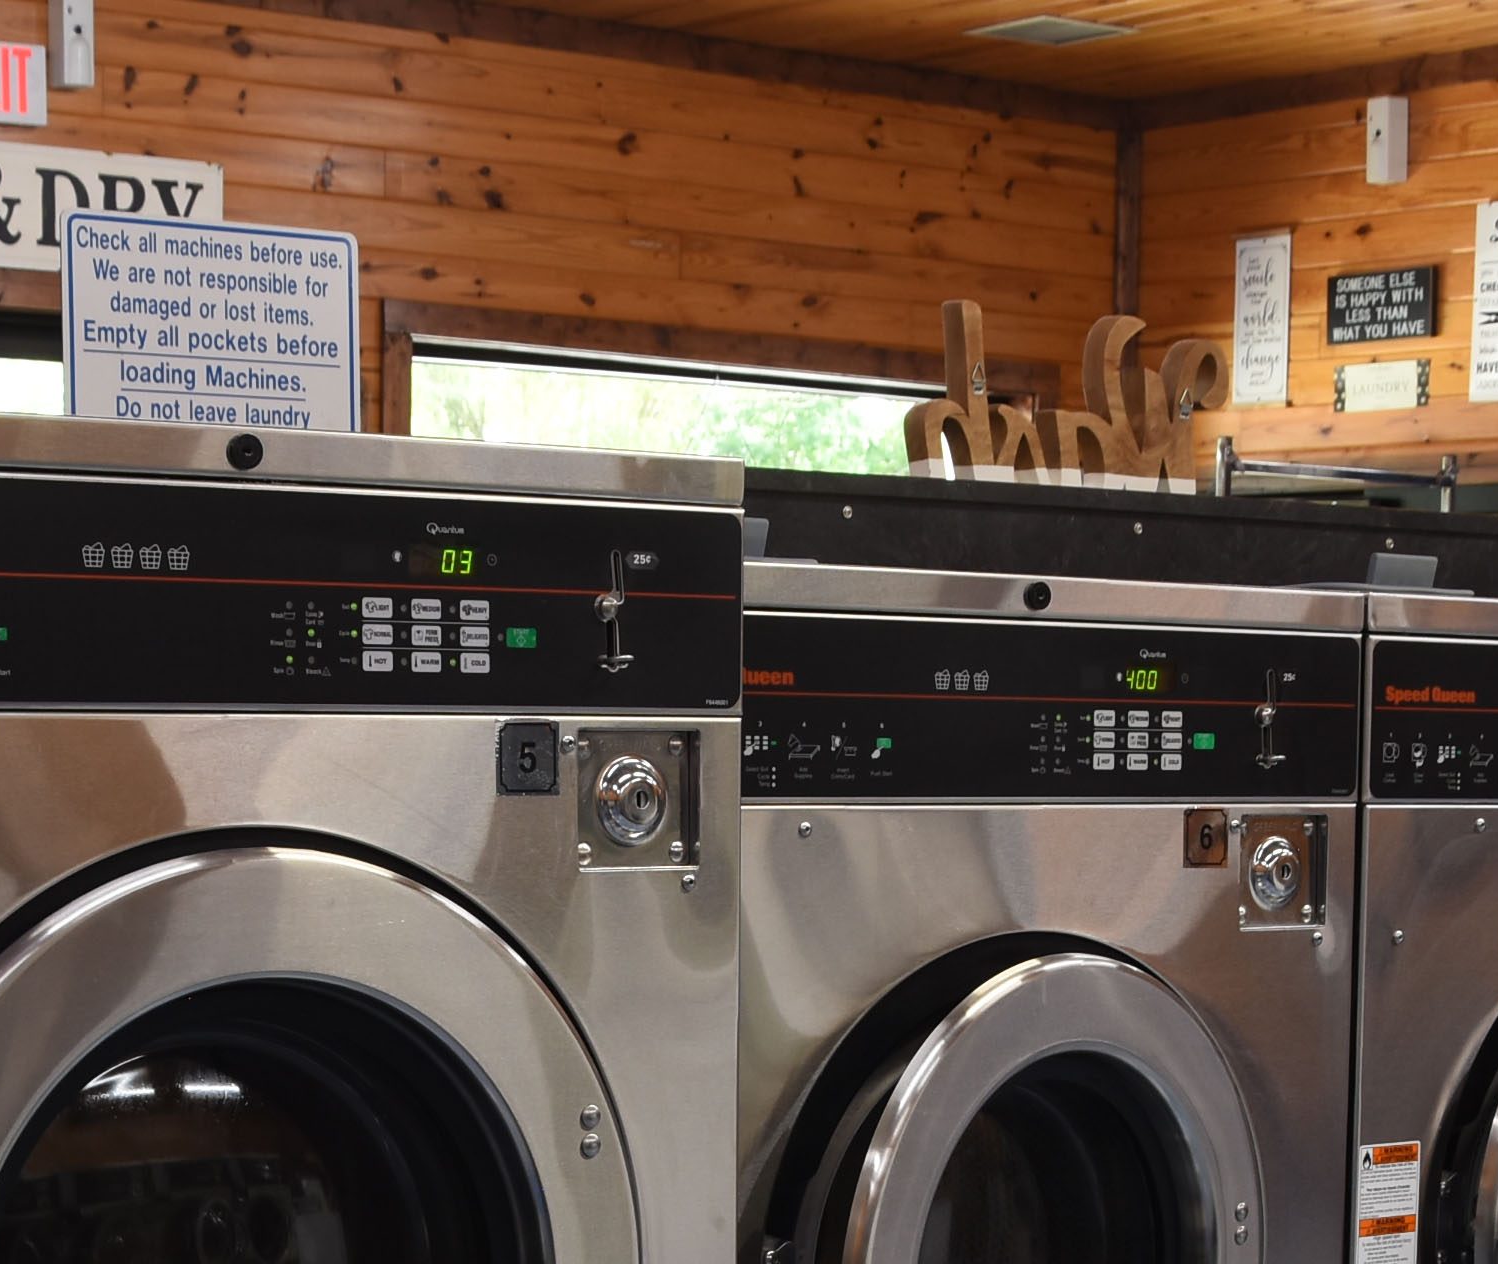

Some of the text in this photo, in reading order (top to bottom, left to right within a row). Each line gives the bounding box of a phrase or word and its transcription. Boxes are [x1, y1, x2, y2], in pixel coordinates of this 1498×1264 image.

[77, 226, 342, 269] Check all machines before use.
[93, 258, 327, 298] We are not responsible for
[1336, 271, 1415, 293] SOMEONE ELSE
[110, 291, 313, 326] damaged or lost items.
[1335, 286, 1423, 309] IS HAPPY WITH
[1346, 305, 1408, 324] LESS THAN
[83, 320, 337, 358] Empty all pockets before
[1333, 319, 1425, 342] WHAT YOU HAVE
[121, 360, 306, 392] loading Machines.
[1477, 361, 1498, 374] HAVE
[1352, 381, 1410, 396] LAUNDRY
[116, 396, 310, 428] Do not leave laundry
[441, 550, 473, 574] 03
[633, 554, 651, 566] 25¢
[743, 667, 794, 685] ueen
[1385, 685, 1476, 704] Speed Queen
[517, 741, 538, 774] 5
[1200, 824, 1213, 849] 6
